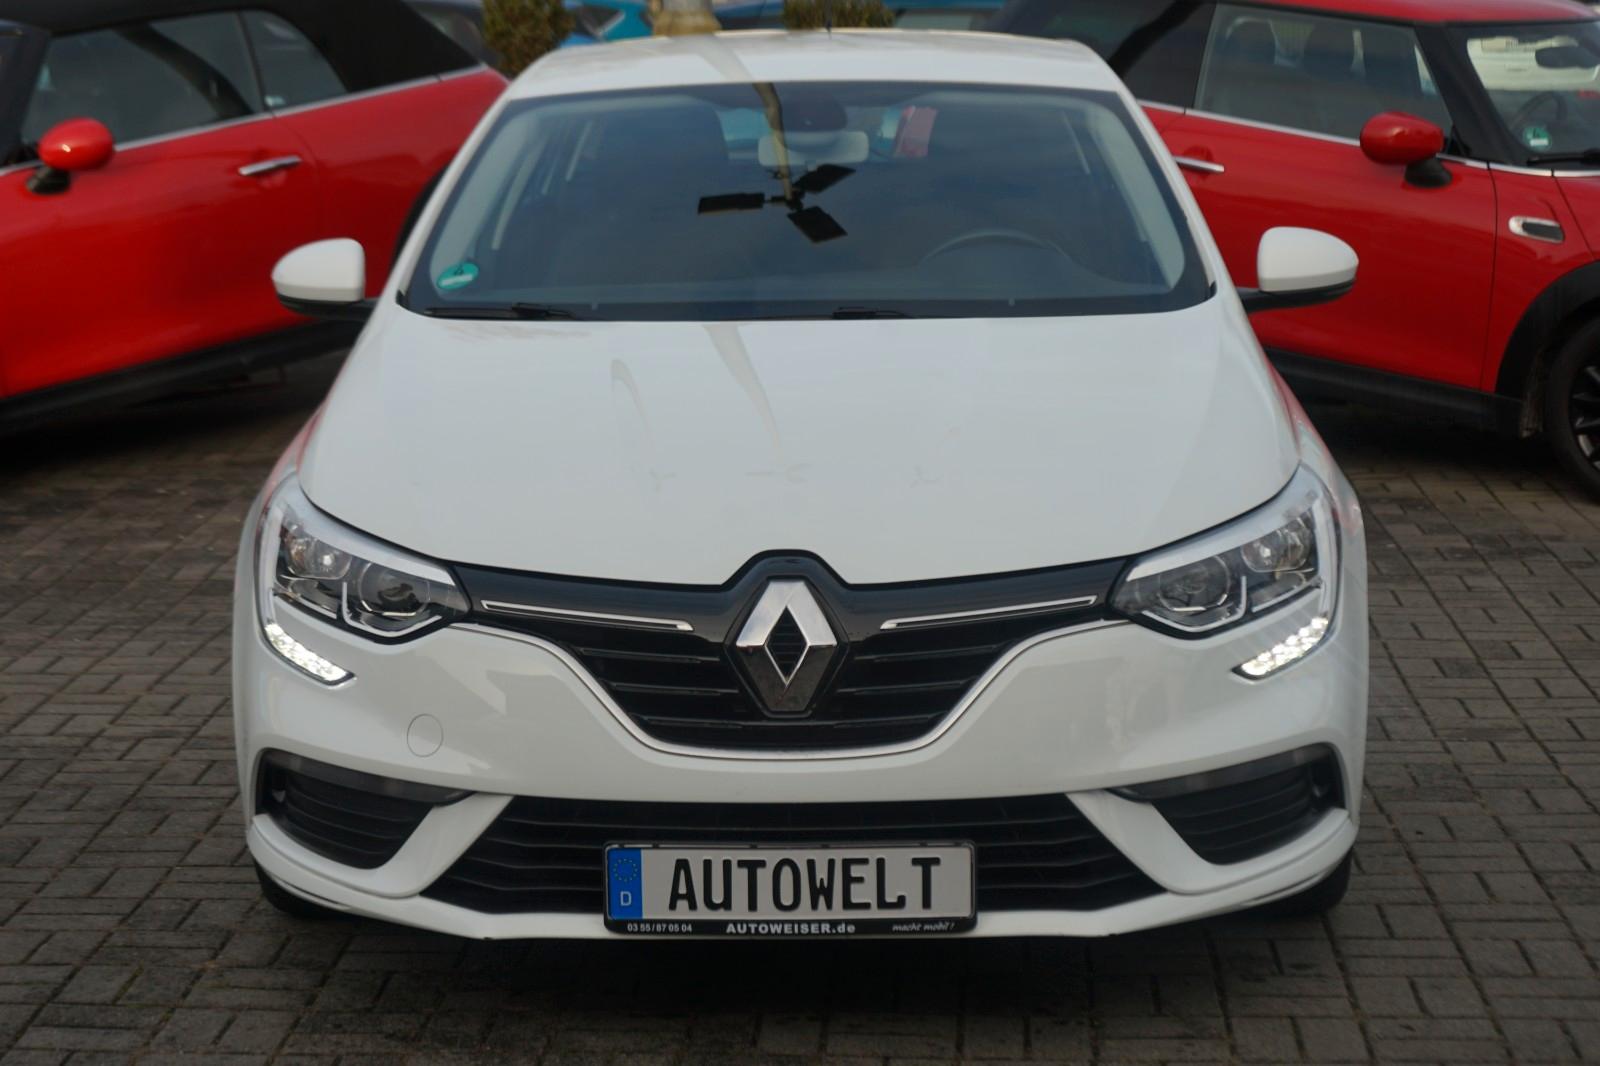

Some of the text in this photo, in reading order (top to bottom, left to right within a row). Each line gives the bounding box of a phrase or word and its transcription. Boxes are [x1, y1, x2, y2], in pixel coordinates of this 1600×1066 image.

[668, 857, 941, 912] AUTOWELT
[620, 891, 632, 906] D
[726, 923, 856, 934] AUTOWEISER.de
